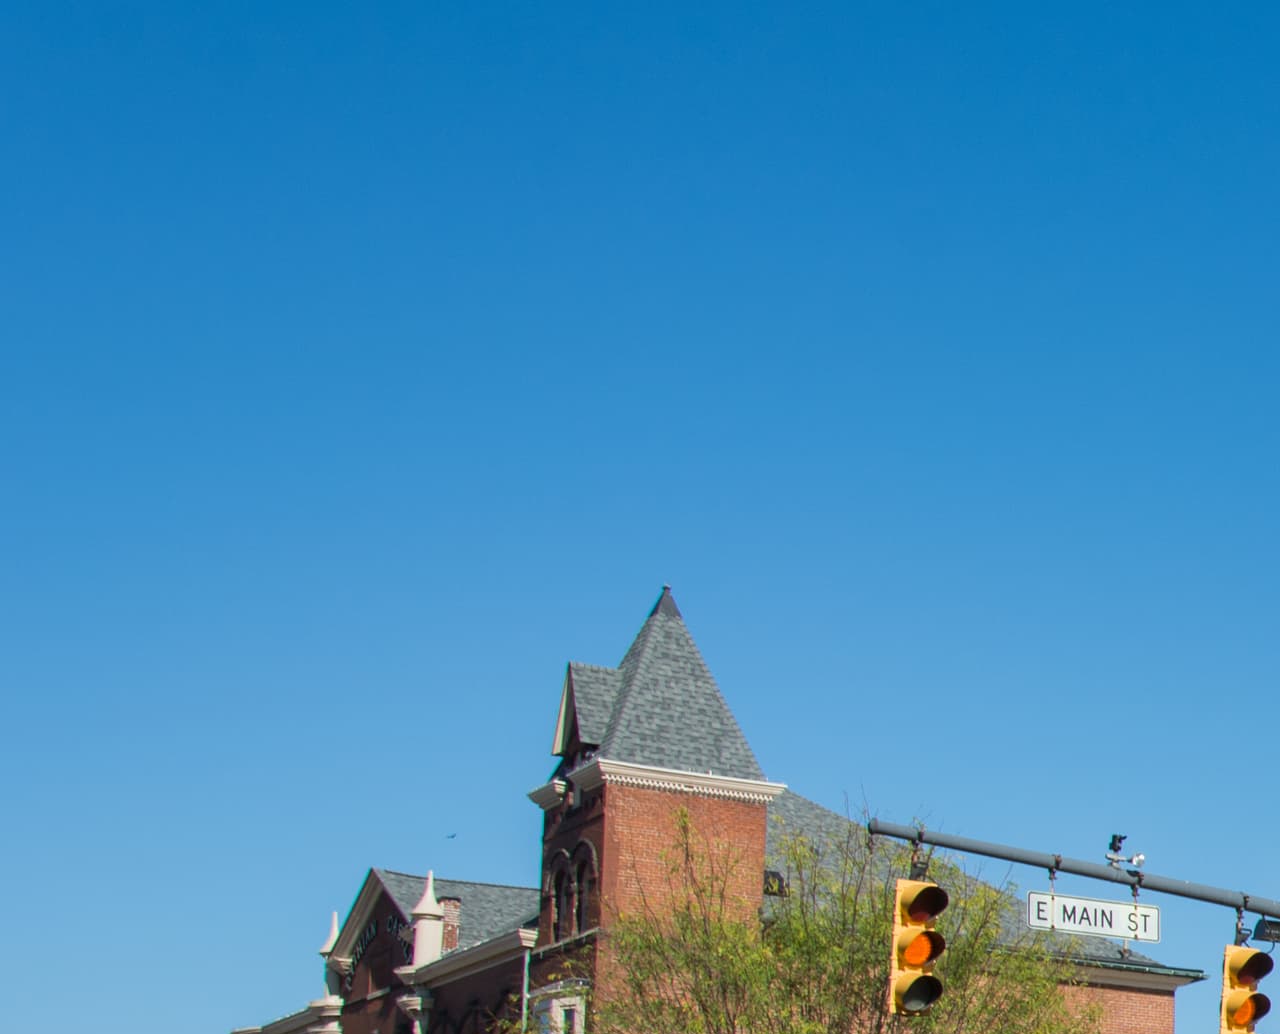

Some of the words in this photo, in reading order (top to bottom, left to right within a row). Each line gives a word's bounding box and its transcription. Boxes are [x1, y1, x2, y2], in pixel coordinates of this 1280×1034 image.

[1036, 901, 1048, 921] E
[1062, 904, 1113, 929] MAIN
[1127, 912, 1151, 933] ST
